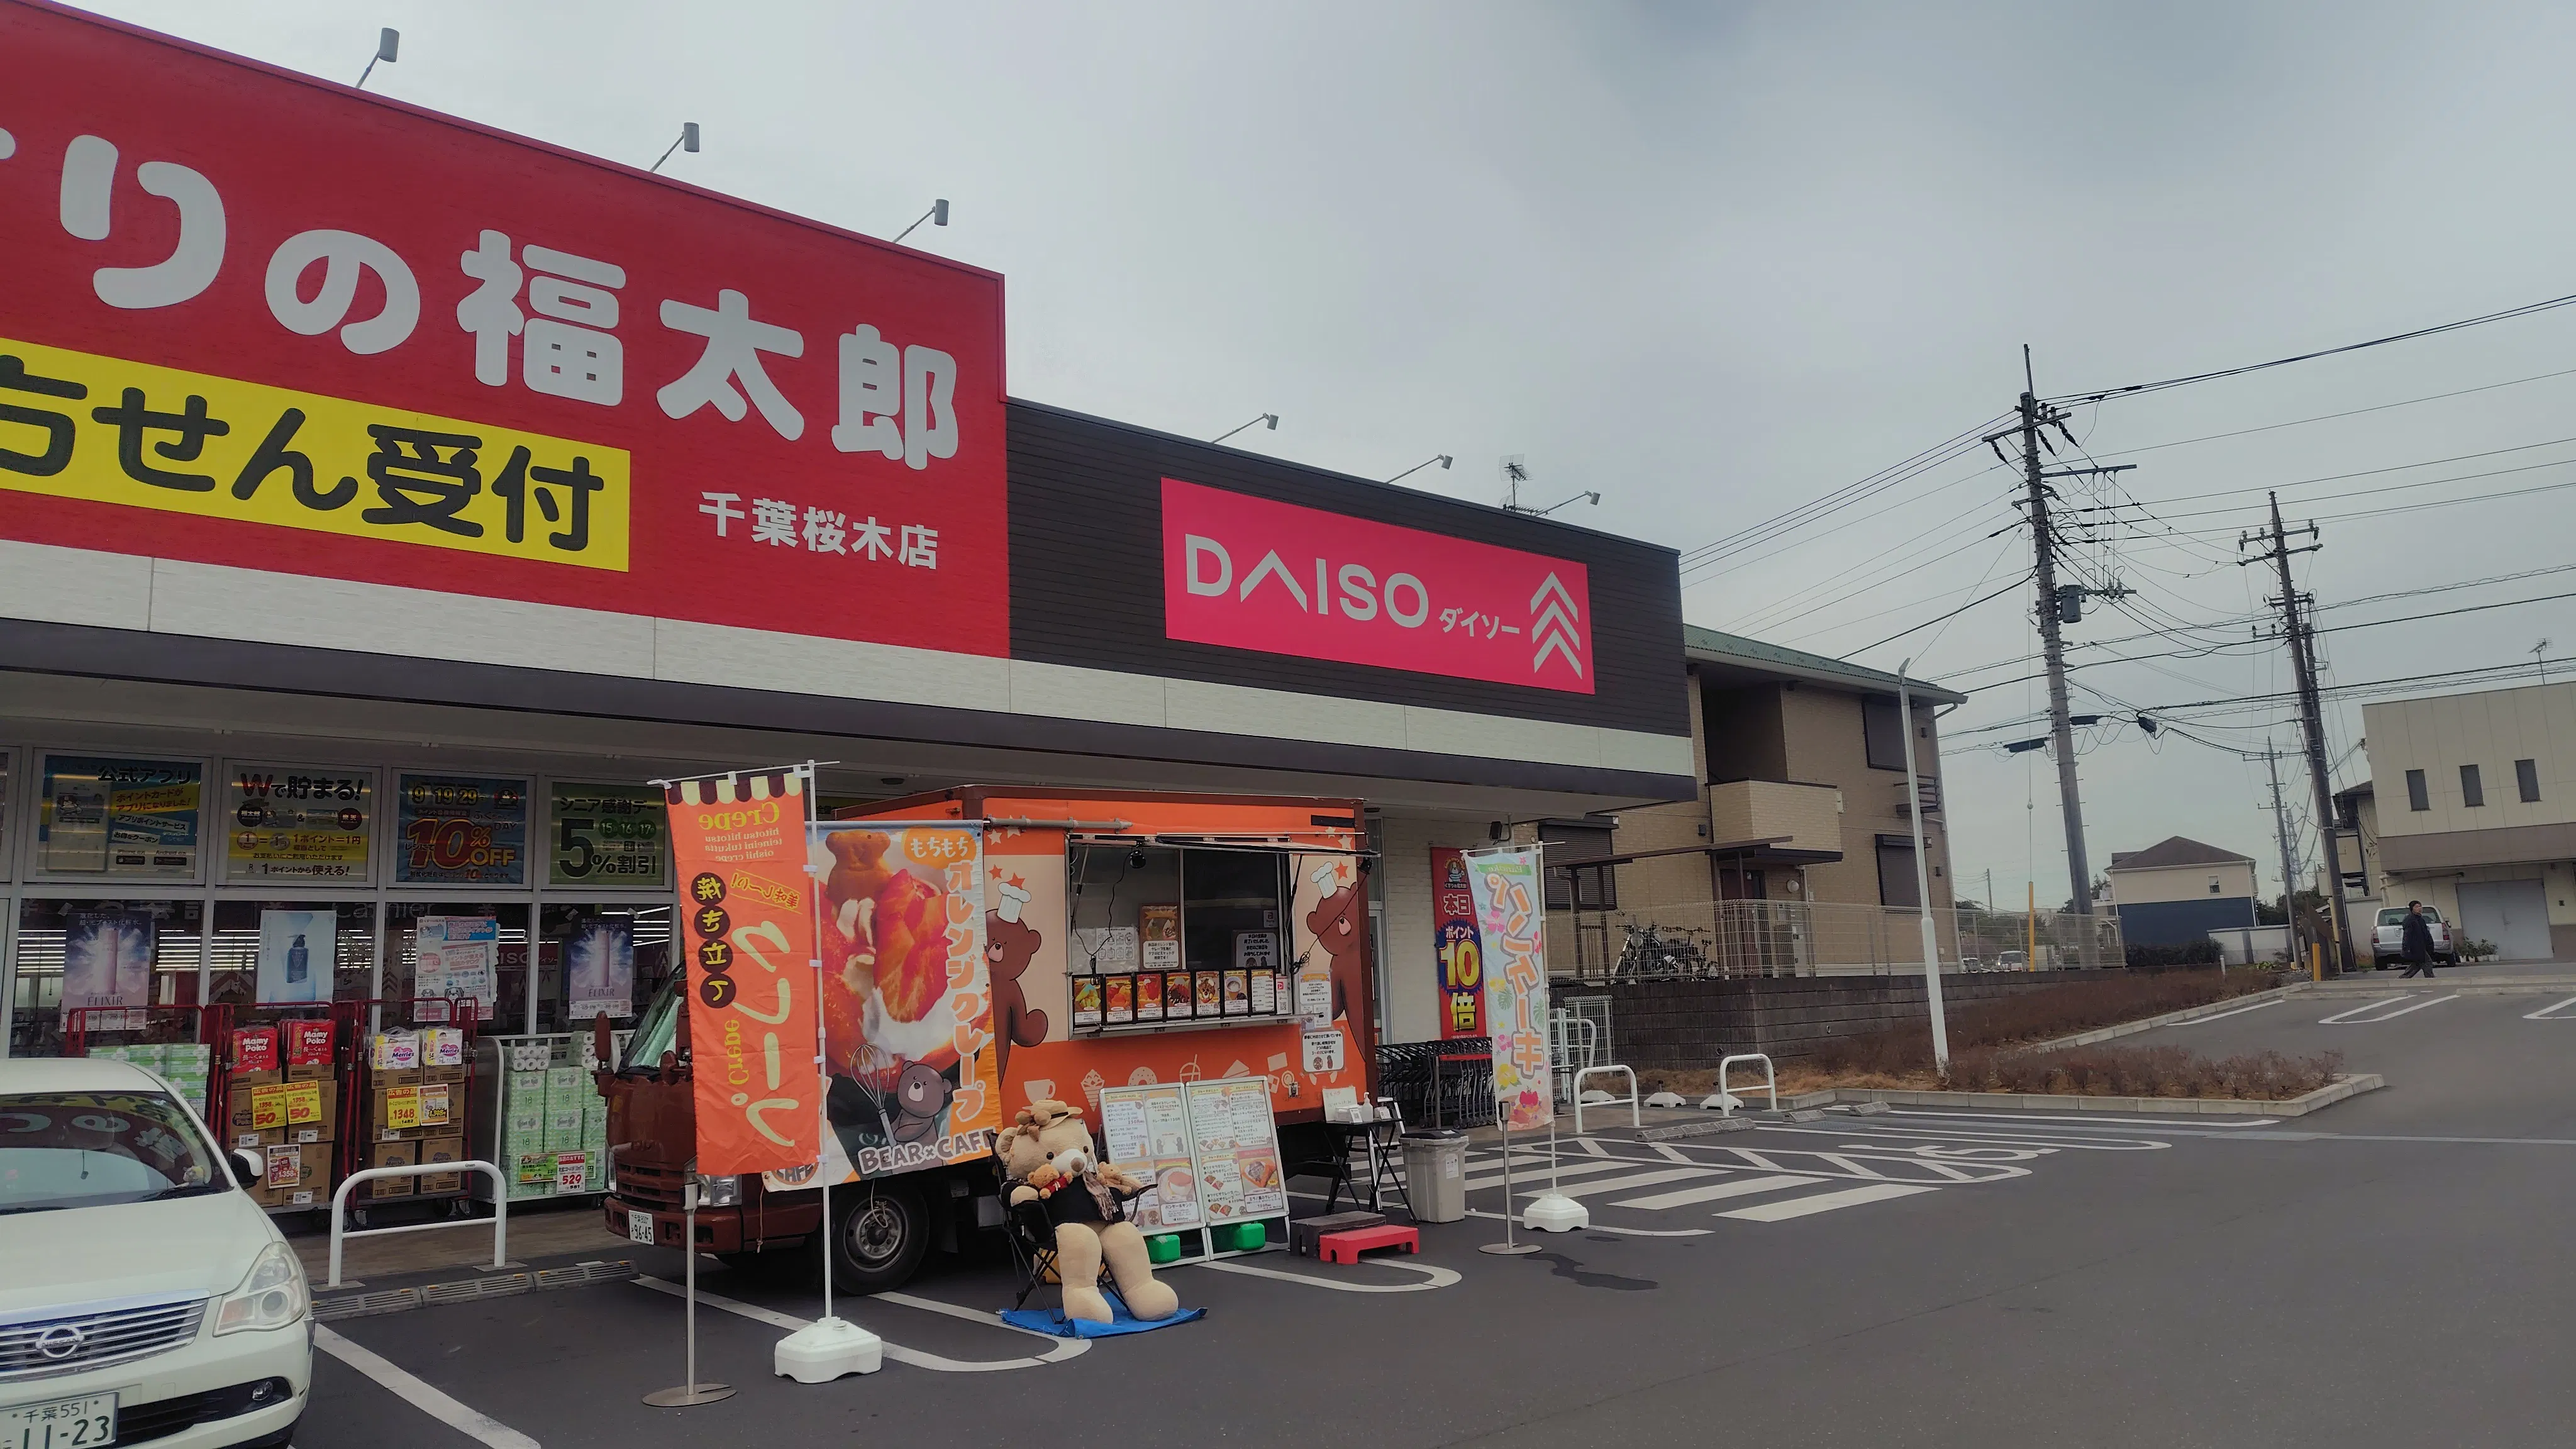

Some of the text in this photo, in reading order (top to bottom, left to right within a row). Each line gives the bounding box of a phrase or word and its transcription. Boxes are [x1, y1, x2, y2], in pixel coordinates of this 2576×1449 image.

[0, 129, 959, 470] りの福太郎
[699, 492, 939, 570] 千葉桜木店
[1185, 534, 1520, 640] DAISO ダイソー
[97, 765, 191, 784] 公式アプリ
[240, 772, 364, 801] Wで貯まる!
[116, 787, 184, 802] ポイントカードが
[560, 796, 658, 814] シニア感謝デー
[118, 814, 187, 831] アプリポイントサービス
[911, 836, 969, 858] もちもち
[470, 848, 516, 867] OFF
[1443, 893, 1471, 916] 本日
[1445, 926, 1475, 939] ポイント
[1440, 939, 1480, 989] 10
[588, 987, 615, 997] ELIXIR
[946, 860, 986, 1123] オレンジクレープ
[87, 996, 123, 1006] ELIXIR
[1450, 992, 1478, 1032] 倍
[304, 1031, 328, 1039] Mamy
[306, 1037, 326, 1045] Poko
[242, 1038, 269, 1046] Mamy
[245, 1044, 268, 1053] Poko
[525, 1096, 533, 1104] 18
[562, 1094, 570, 1102] 18
[255, 1112, 276, 1126] 50
[289, 1107, 310, 1119] 50
[393, 1108, 415, 1120] 1348
[522, 1138, 530, 1146] 18
[562, 1136, 570, 1144] 18
[562, 1174, 582, 1185] 529
[42, 1337, 79, 1348] NISSAN
